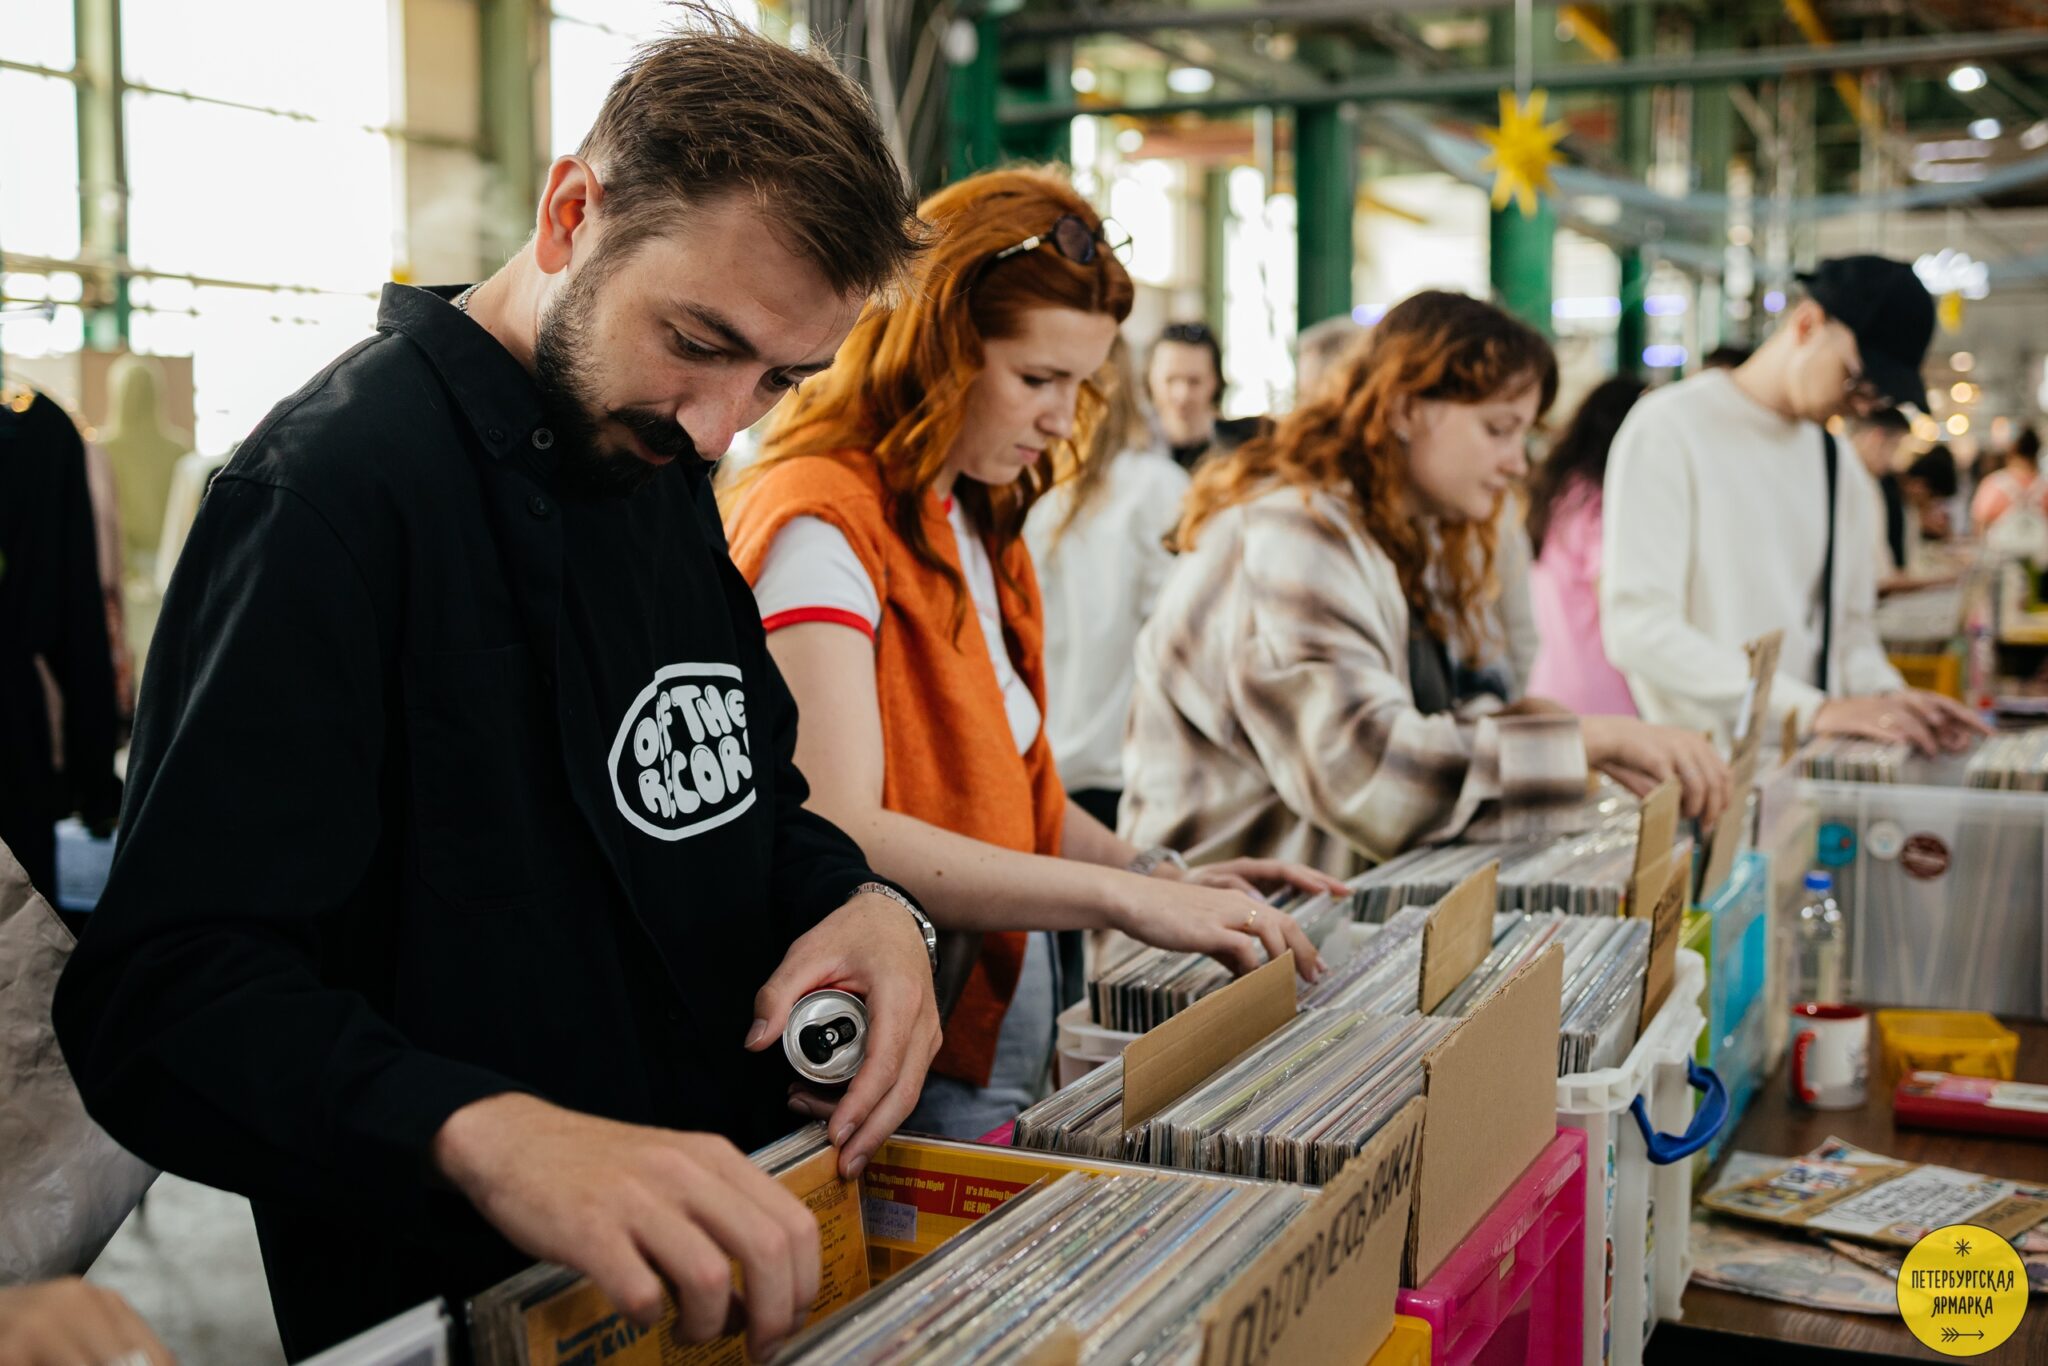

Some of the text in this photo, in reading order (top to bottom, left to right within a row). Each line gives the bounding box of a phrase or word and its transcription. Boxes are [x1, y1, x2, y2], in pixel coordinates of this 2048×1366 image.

[670, 684, 747, 743] THE
[905, 1177, 913, 1188] Of
[914, 1178, 926, 1190] The
[926, 1180, 945, 1191] Night
[966, 1185, 978, 1196] It's
[978, 1187, 984, 1197] A
[984, 1188, 1004, 1200] Rainy
[963, 1200, 991, 1214] ICE MC
